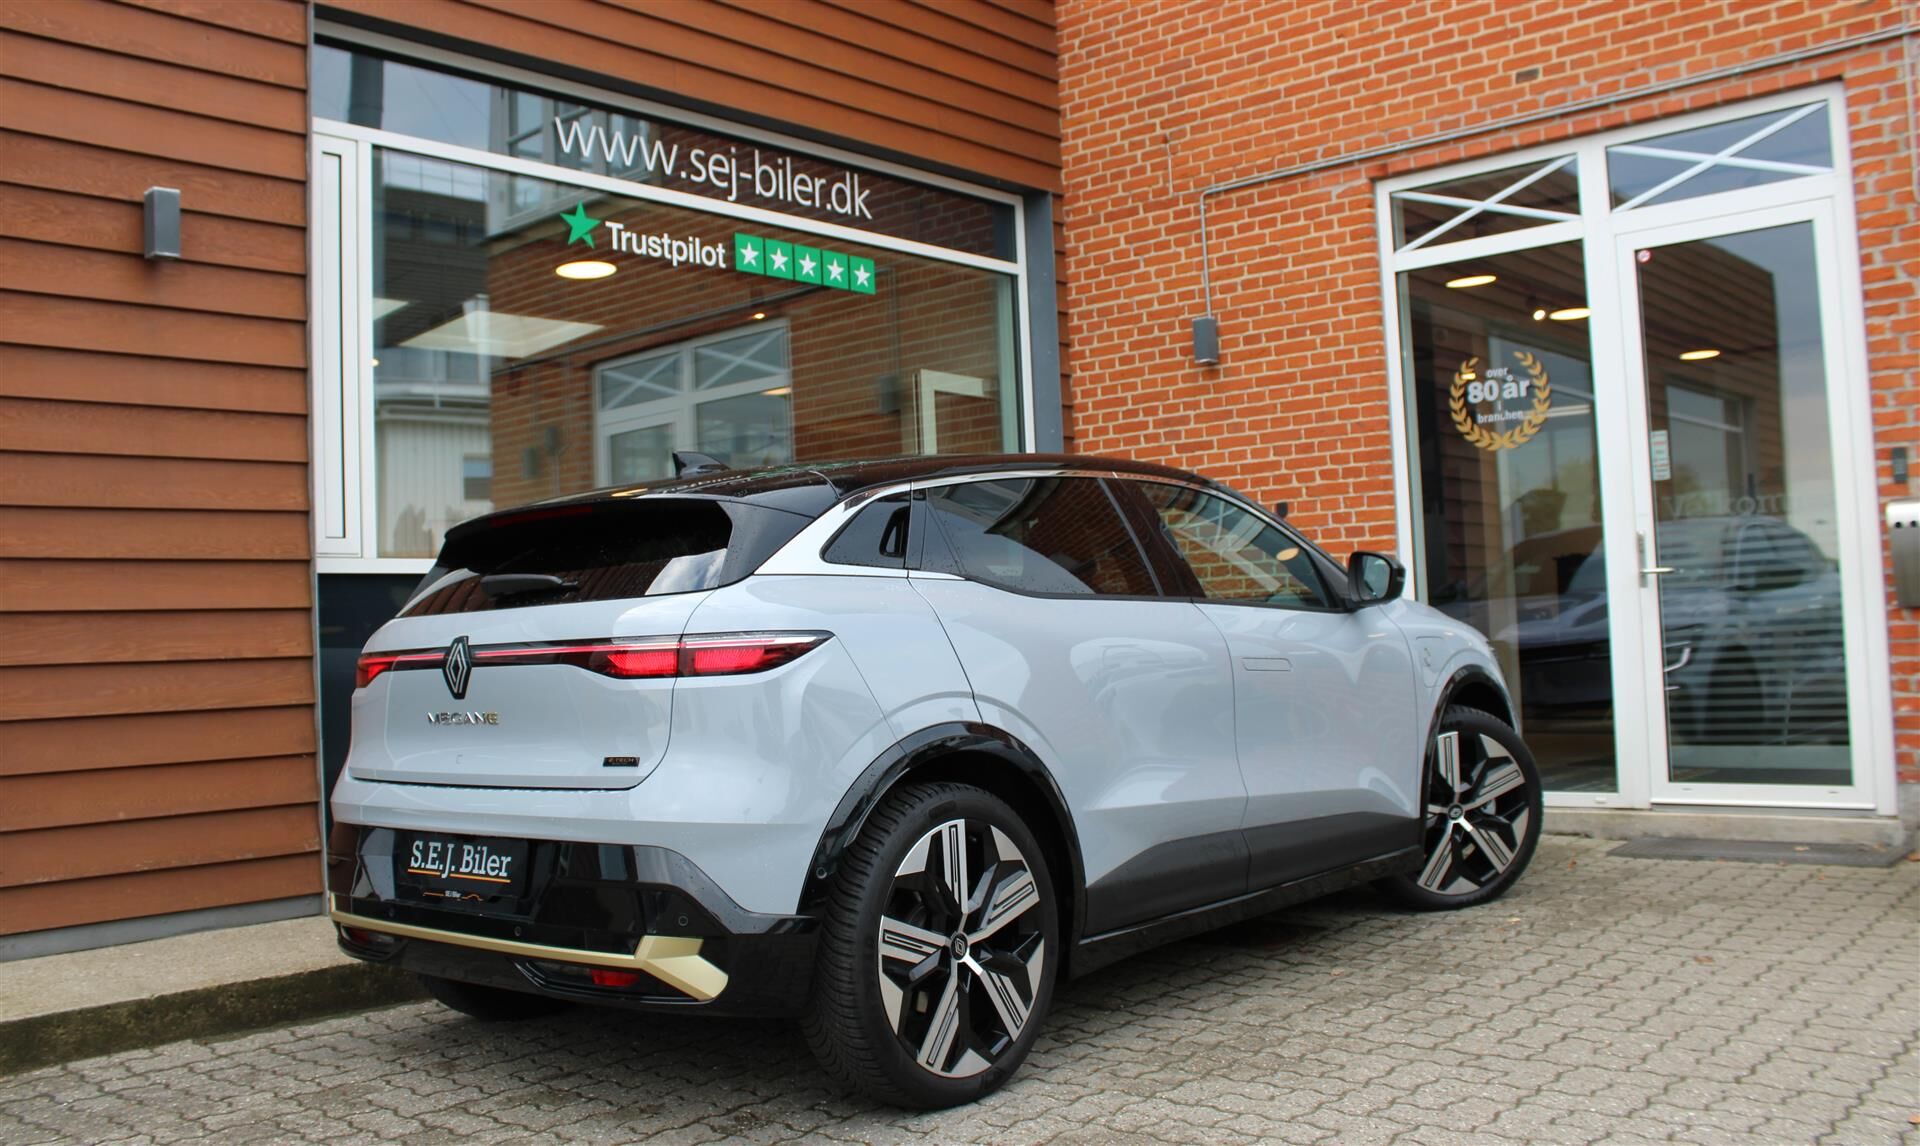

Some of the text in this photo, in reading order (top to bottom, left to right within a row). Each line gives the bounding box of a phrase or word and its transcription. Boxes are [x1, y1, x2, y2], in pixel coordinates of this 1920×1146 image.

[555, 117, 872, 219] www.sej-biler.dk
[605, 221, 726, 268] Trustpilot
[1467, 375, 1530, 403] 80 år
[1486, 367, 1508, 378] over
[427, 711, 498, 725] MEGANE
[410, 840, 512, 879] S.E.J. Biler
